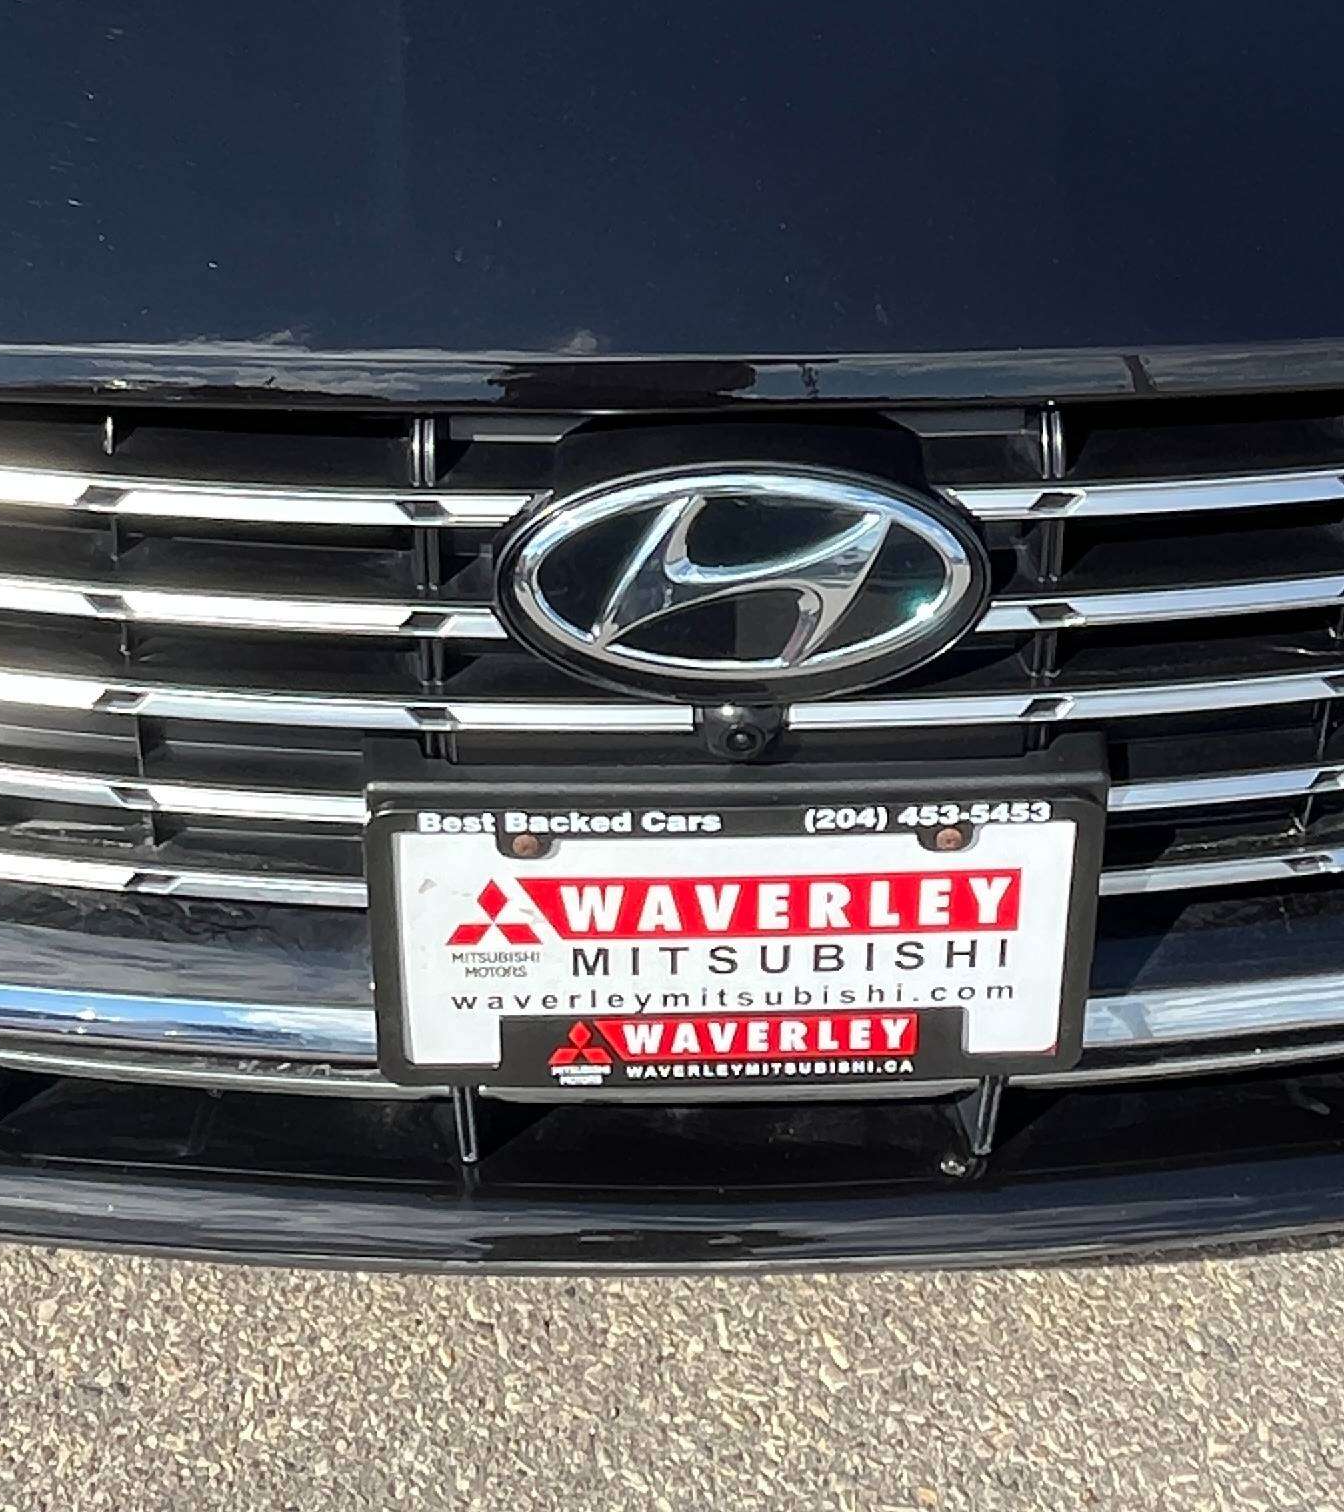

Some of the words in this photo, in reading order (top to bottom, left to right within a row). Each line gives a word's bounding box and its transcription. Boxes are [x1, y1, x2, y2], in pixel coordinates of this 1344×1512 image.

[417, 811, 496, 833] Best
[505, 811, 632, 833] Backed
[641, 811, 723, 833] Cars
[805, 807, 888, 833] (204)
[897, 801, 1052, 827] 453-5453
[559, 876, 1013, 932] WAVERLEY
[452, 951, 540, 963] MITSUBISHI
[464, 964, 528, 978] MOTORS
[572, 938, 1008, 977] MITSUBISHI
[451, 983, 1014, 1014] waverleymitsubishi.com
[622, 1016, 911, 1055] WAVERLEY
[626, 1059, 914, 1078] WAVERLEYMITSUBISHI.CA
